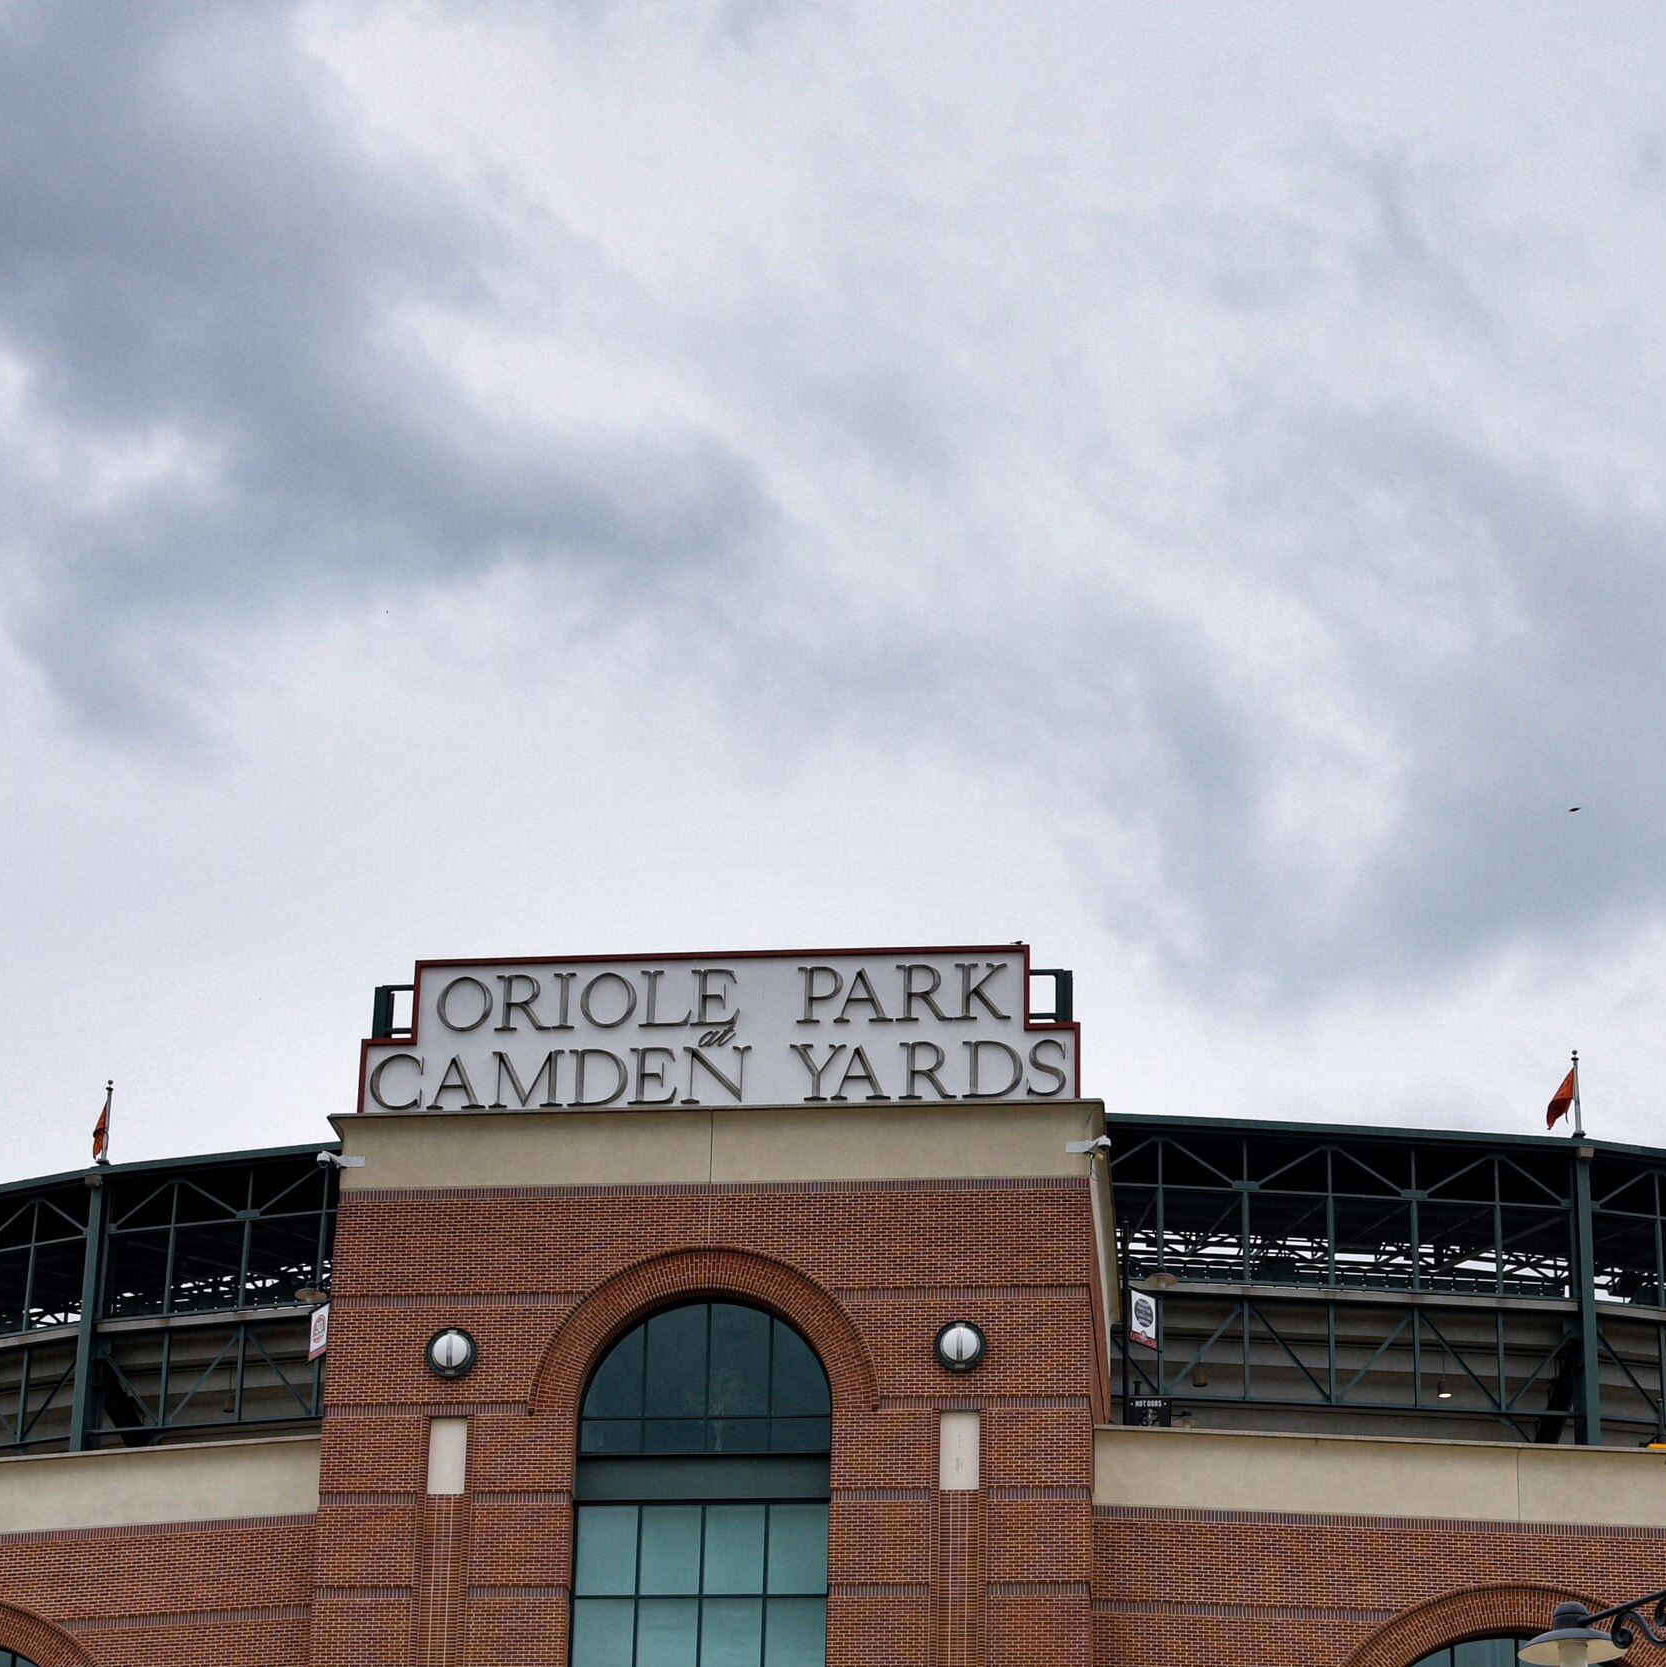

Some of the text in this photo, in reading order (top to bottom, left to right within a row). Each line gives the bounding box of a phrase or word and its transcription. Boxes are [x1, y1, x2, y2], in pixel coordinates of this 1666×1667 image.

[436, 962, 1010, 1032] ORIOLE PARK
[699, 1024, 738, 1047] at
[369, 1039, 1068, 1110] CAMDEN YARDS
